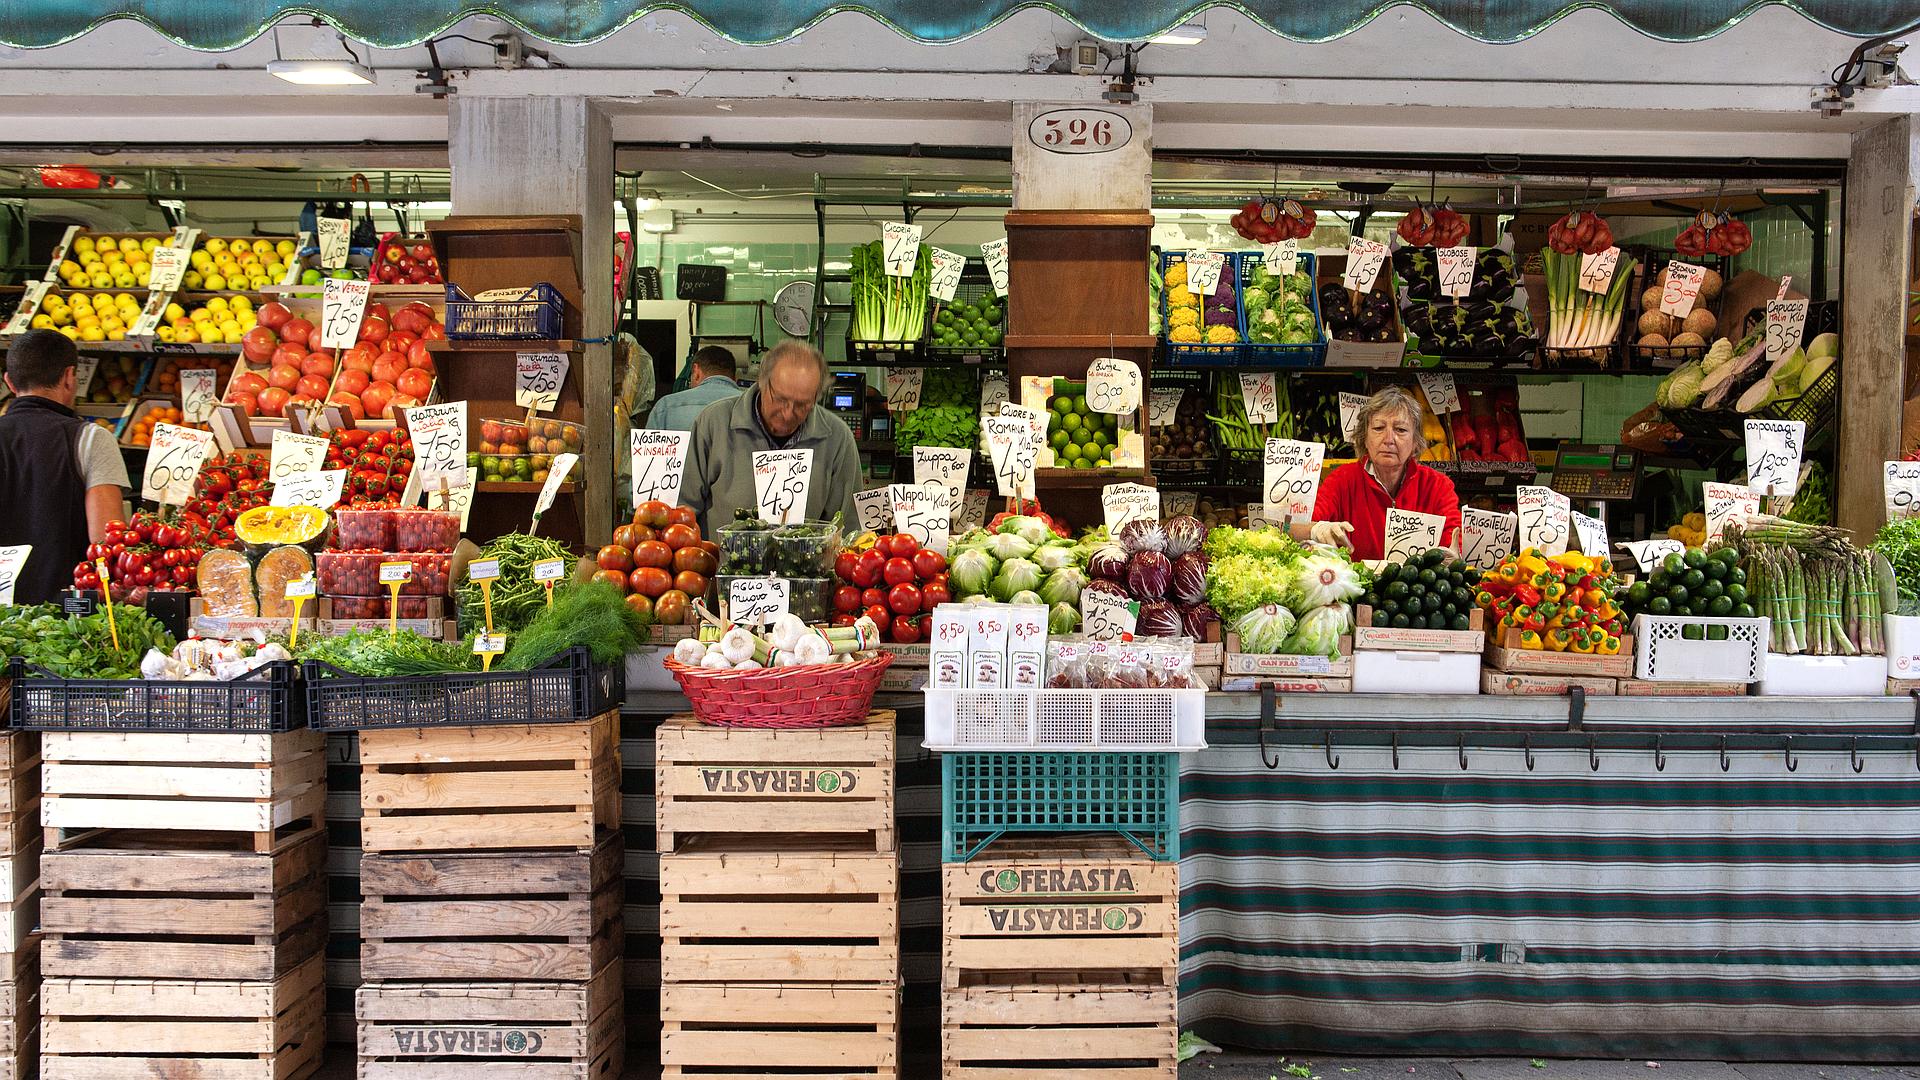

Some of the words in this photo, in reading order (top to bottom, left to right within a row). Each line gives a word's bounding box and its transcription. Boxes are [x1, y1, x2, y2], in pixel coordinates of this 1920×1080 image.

[1045, 119, 1111, 146] 326
[1001, 404, 1027, 419] CUORE
[633, 432, 682, 446] NOSTRANO
[1746, 421, 1797, 441] asparagi
[666, 457, 682, 472] Kilo
[755, 452, 806, 470] ZUCCHINE
[789, 458, 808, 477] Kilo
[893, 486, 932, 504] NAPOLI
[1103, 494, 1149, 507] CHIOGGIA
[1463, 510, 1513, 532] FRIGGITELLI
[1494, 531, 1511, 545] Kilo
[732, 581, 763, 591] AGLIO
[731, 592, 769, 603] nuovo
[1088, 592, 1129, 610] POMODORO
[702, 769, 856, 794] COFERASTA
[980, 868, 1135, 893] COFERASTA
[989, 907, 1143, 931] COFERASTA
[394, 1030, 543, 1055] COFERASTA
